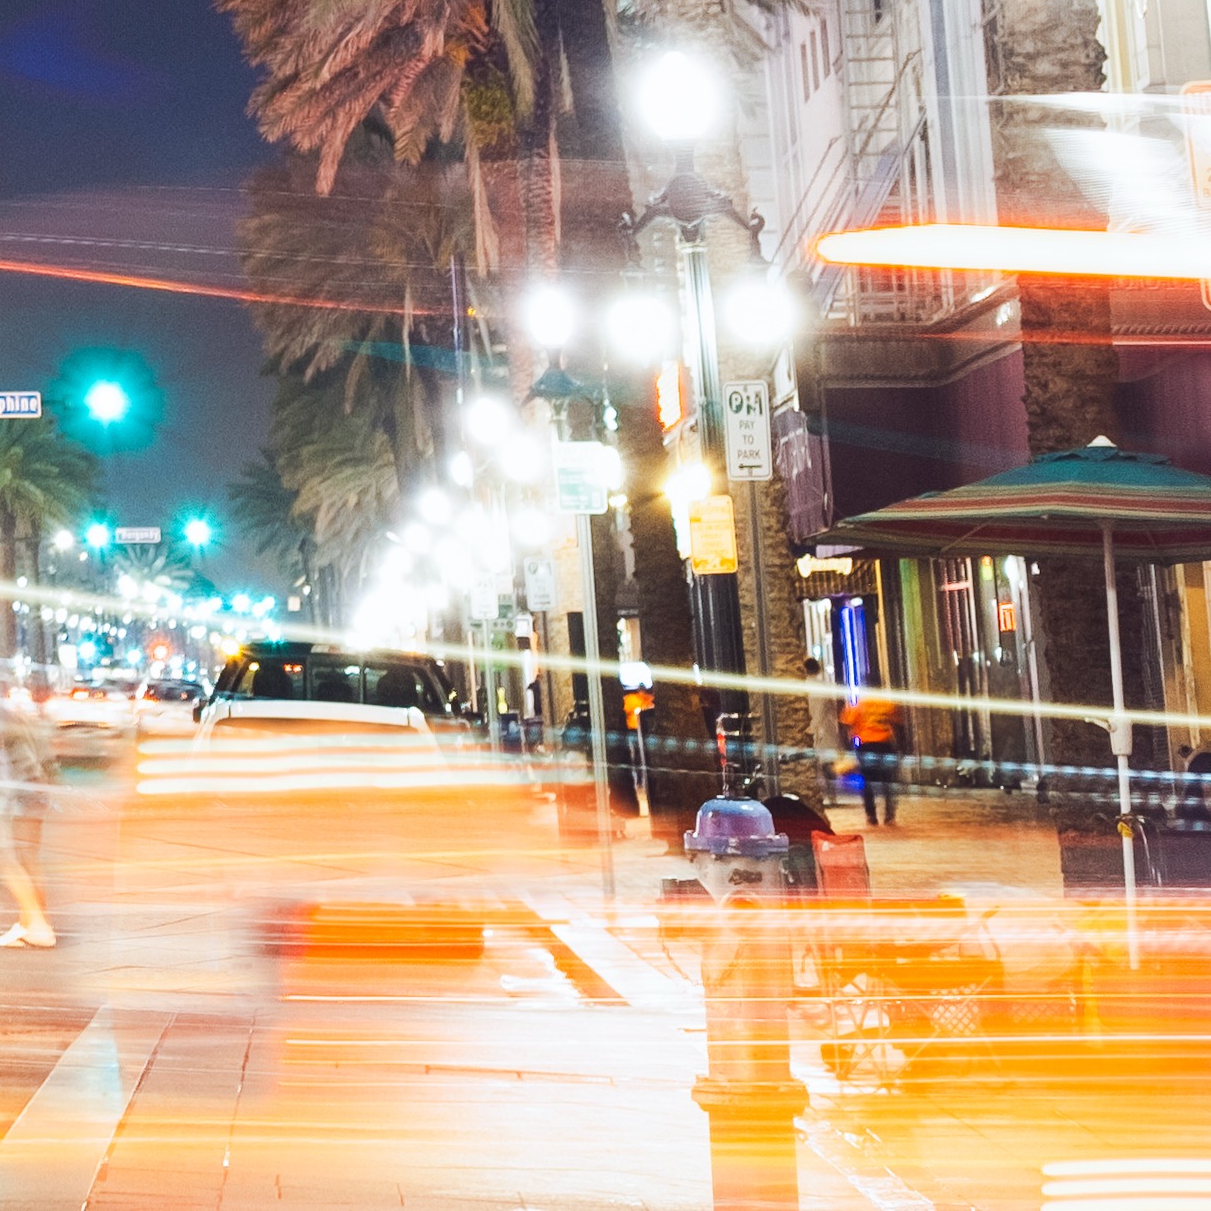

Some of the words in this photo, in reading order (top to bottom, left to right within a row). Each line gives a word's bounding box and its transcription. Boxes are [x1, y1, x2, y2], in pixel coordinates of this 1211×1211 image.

[739, 420, 755, 429] PAY
[742, 435, 754, 444] TO
[737, 450, 760, 459] PARK
